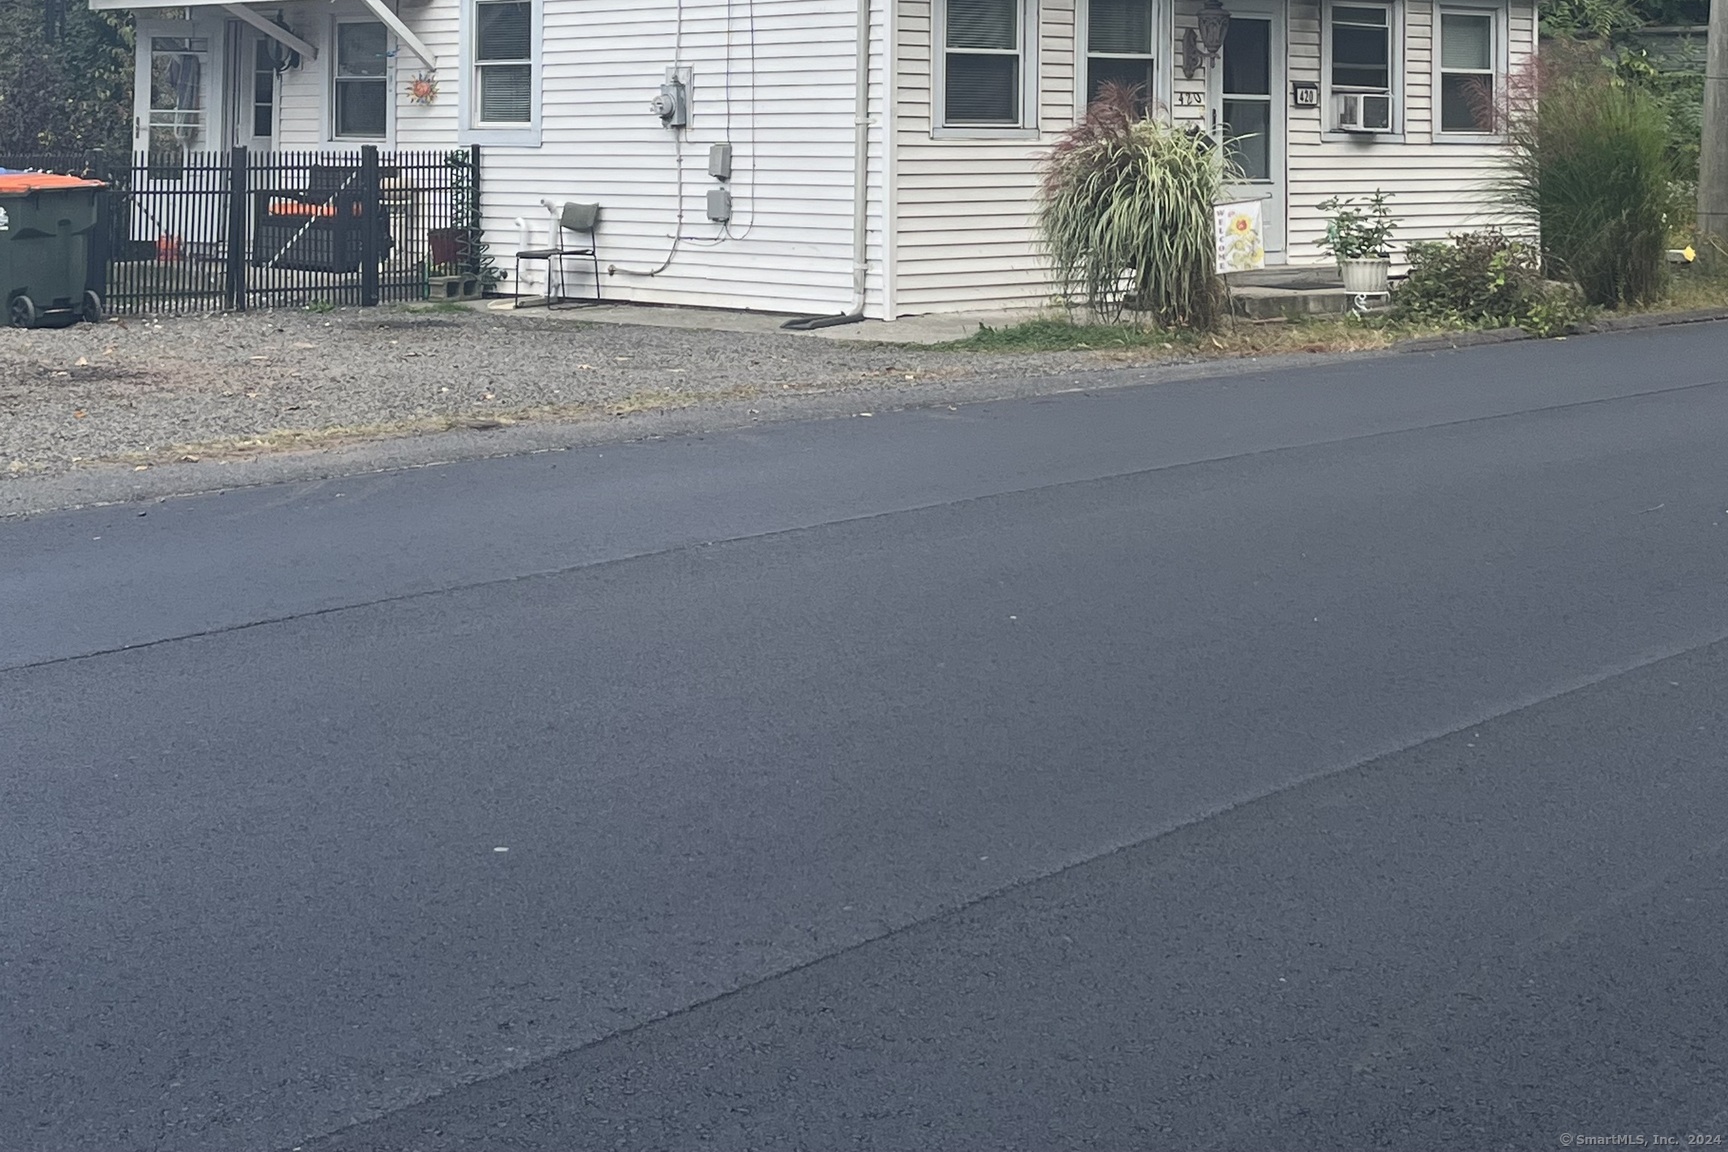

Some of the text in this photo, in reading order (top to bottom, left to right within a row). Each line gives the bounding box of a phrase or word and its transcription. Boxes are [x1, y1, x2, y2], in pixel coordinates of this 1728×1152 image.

[1178, 92, 1202, 106] 420
[1299, 89, 1314, 103] 420
[1216, 209, 1226, 269] WELCOME
